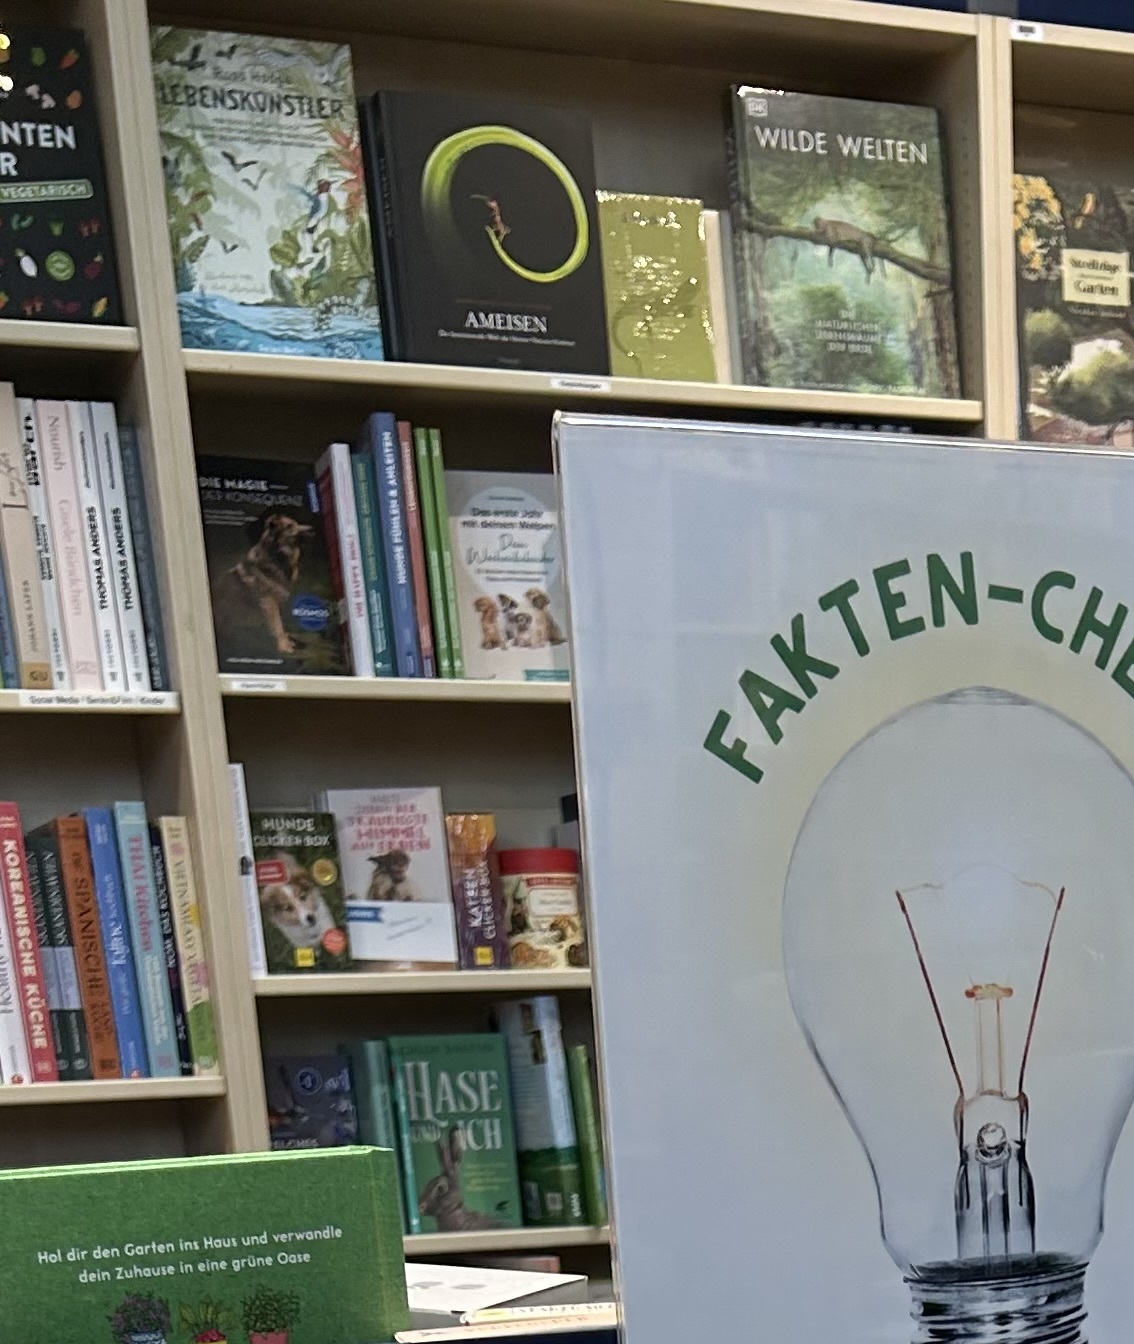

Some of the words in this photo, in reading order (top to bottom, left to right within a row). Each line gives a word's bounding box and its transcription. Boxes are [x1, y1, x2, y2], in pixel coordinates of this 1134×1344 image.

[754, 125, 828, 156] WILDE
[837, 133, 928, 165] WELTEN
[464, 310, 549, 334] AMEISEN
[128, 832, 146, 881] THAI
[2, 838, 38, 978] KOREANISCHE
[24, 982, 48, 1050] KÜCHE
[74, 875, 103, 991] SPANISCHE
[404, 1060, 503, 1124] HASE
[37, 1249, 63, 1265] Hol
[66, 1247, 87, 1263] dir
[92, 1245, 120, 1260] den
[124, 1240, 175, 1258] Garten
[179, 1238, 200, 1253] ins
[203, 1235, 238, 1250] Haus
[241, 1231, 269, 1247] und
[272, 1225, 343, 1245] verwandle
[78, 1268, 111, 1284] dein
[114, 1261, 176, 1281] Zuhause
[179, 1260, 193, 1275] in
[197, 1257, 228, 1272] eine
[231, 1253, 273, 1272] grüne
[276, 1251, 312, 1265] Oase
